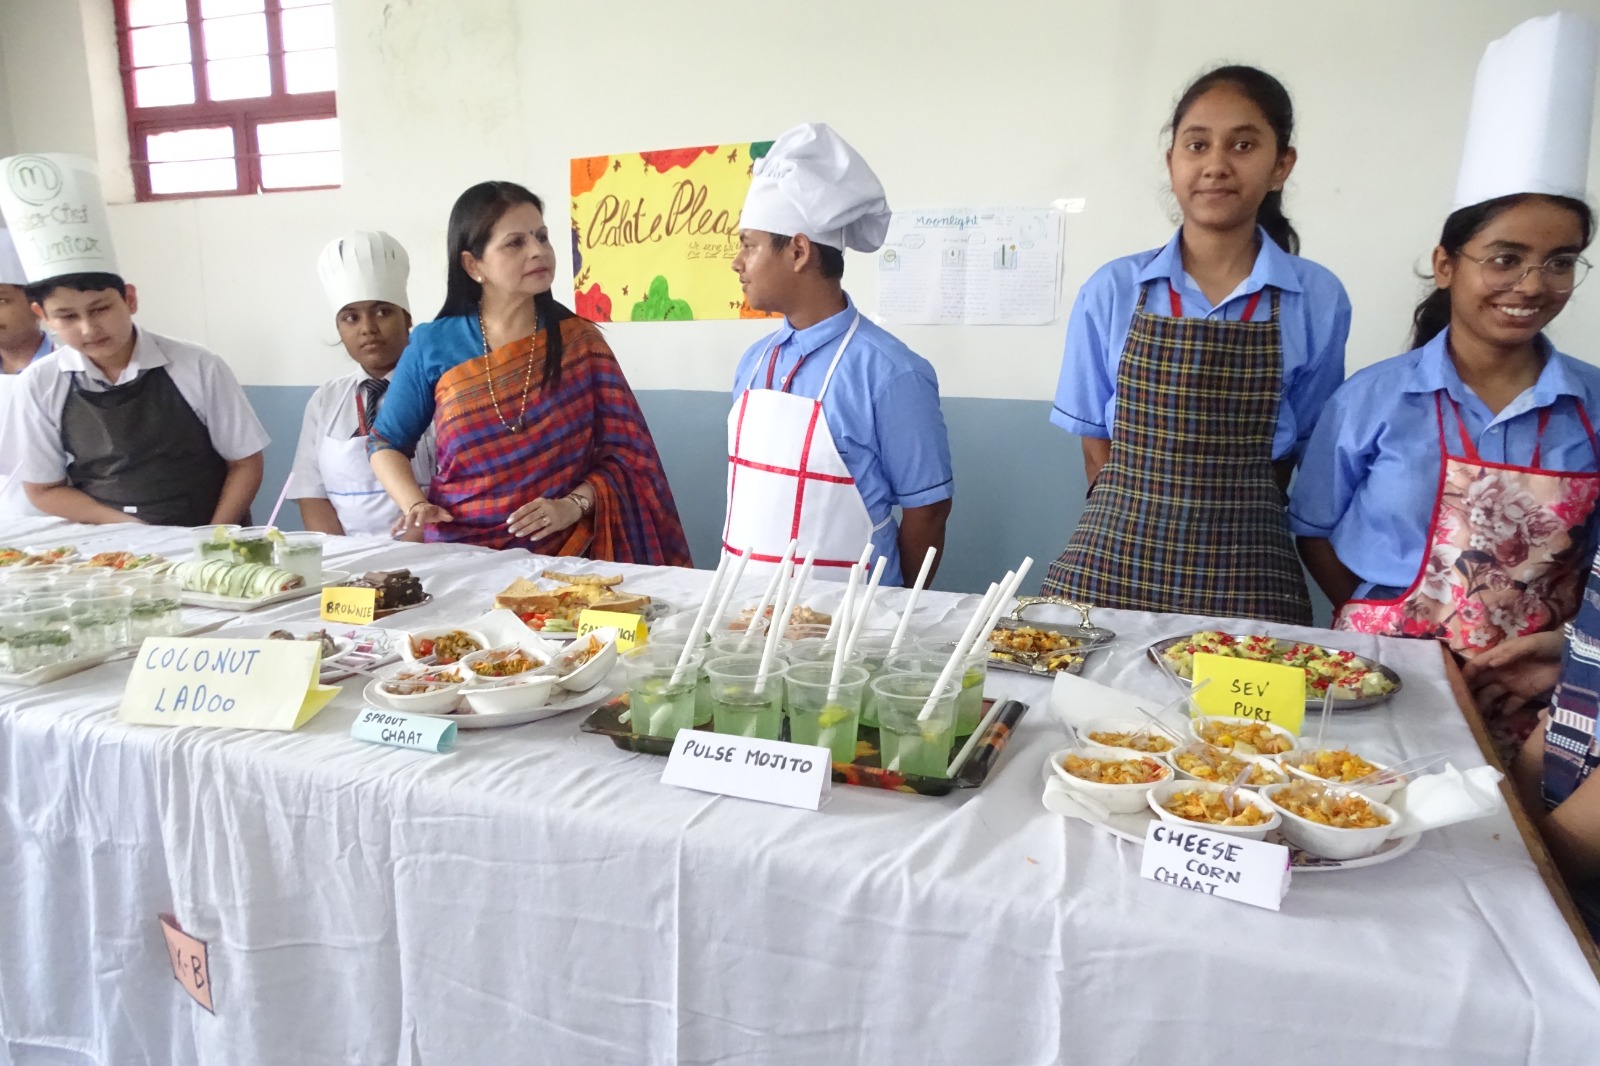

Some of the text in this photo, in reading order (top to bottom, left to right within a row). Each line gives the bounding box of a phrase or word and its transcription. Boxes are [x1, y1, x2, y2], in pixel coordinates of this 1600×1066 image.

[586, 194, 663, 249] Palate
[916, 214, 979, 231] Moonlight
[326, 601, 373, 618] BROWNIE
[145, 647, 260, 676] COCONUT
[1230, 678, 1270, 697] SEV
[362, 712, 408, 727] SPROUT
[1233, 701, 1272, 722] PURI
[682, 739, 813, 774] PULSE MOJITO
[1153, 826, 1244, 862] CHEESE
[1153, 866, 1219, 896] CHAAT
[1185, 858, 1241, 884] CORN
